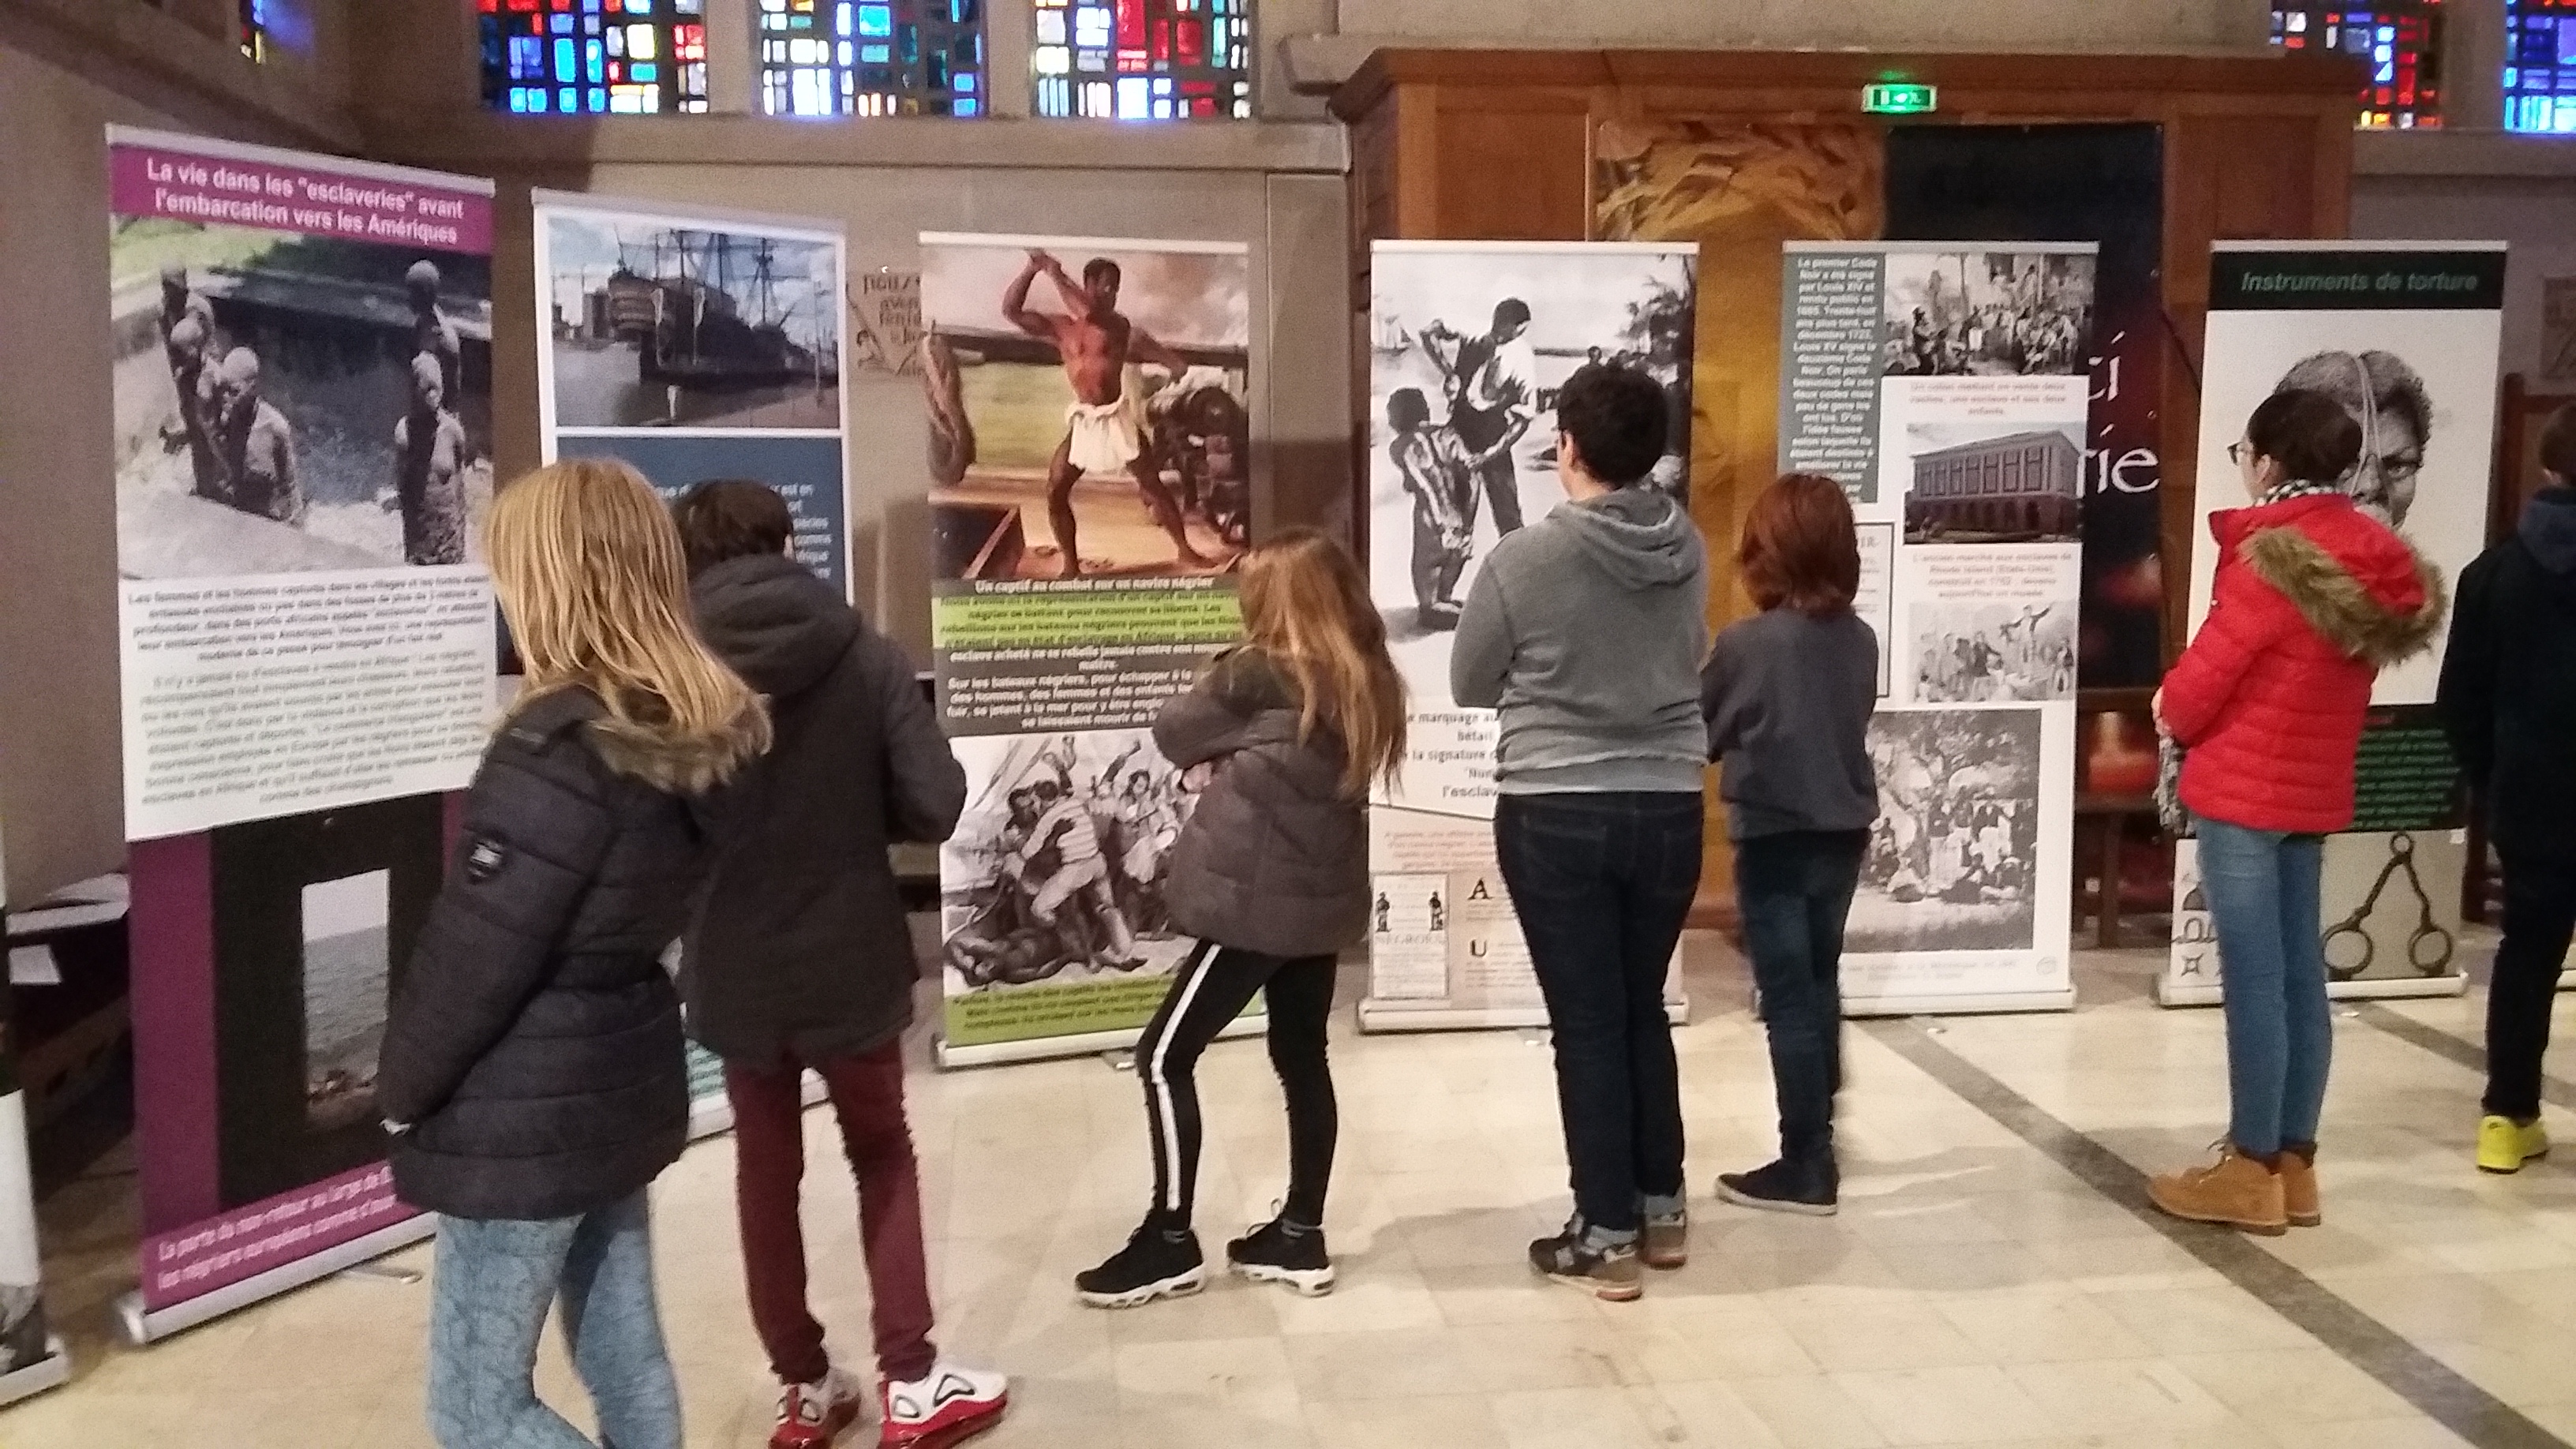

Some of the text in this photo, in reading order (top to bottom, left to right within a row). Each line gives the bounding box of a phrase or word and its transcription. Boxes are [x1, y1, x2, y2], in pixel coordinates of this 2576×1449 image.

[147, 156, 173, 182] La
[178, 163, 208, 188] vie
[212, 167, 261, 194] dans
[265, 172, 294, 198] les
[417, 197, 465, 220] avant
[155, 186, 459, 246] l'embarcation vers les Amériques
[2241, 271, 2480, 291] Instruments de torture
[1428, 749, 1486, 764] signature
[1441, 784, 1498, 799] l'esclav
[1467, 876, 1495, 900] A
[1470, 938, 1488, 958] U
